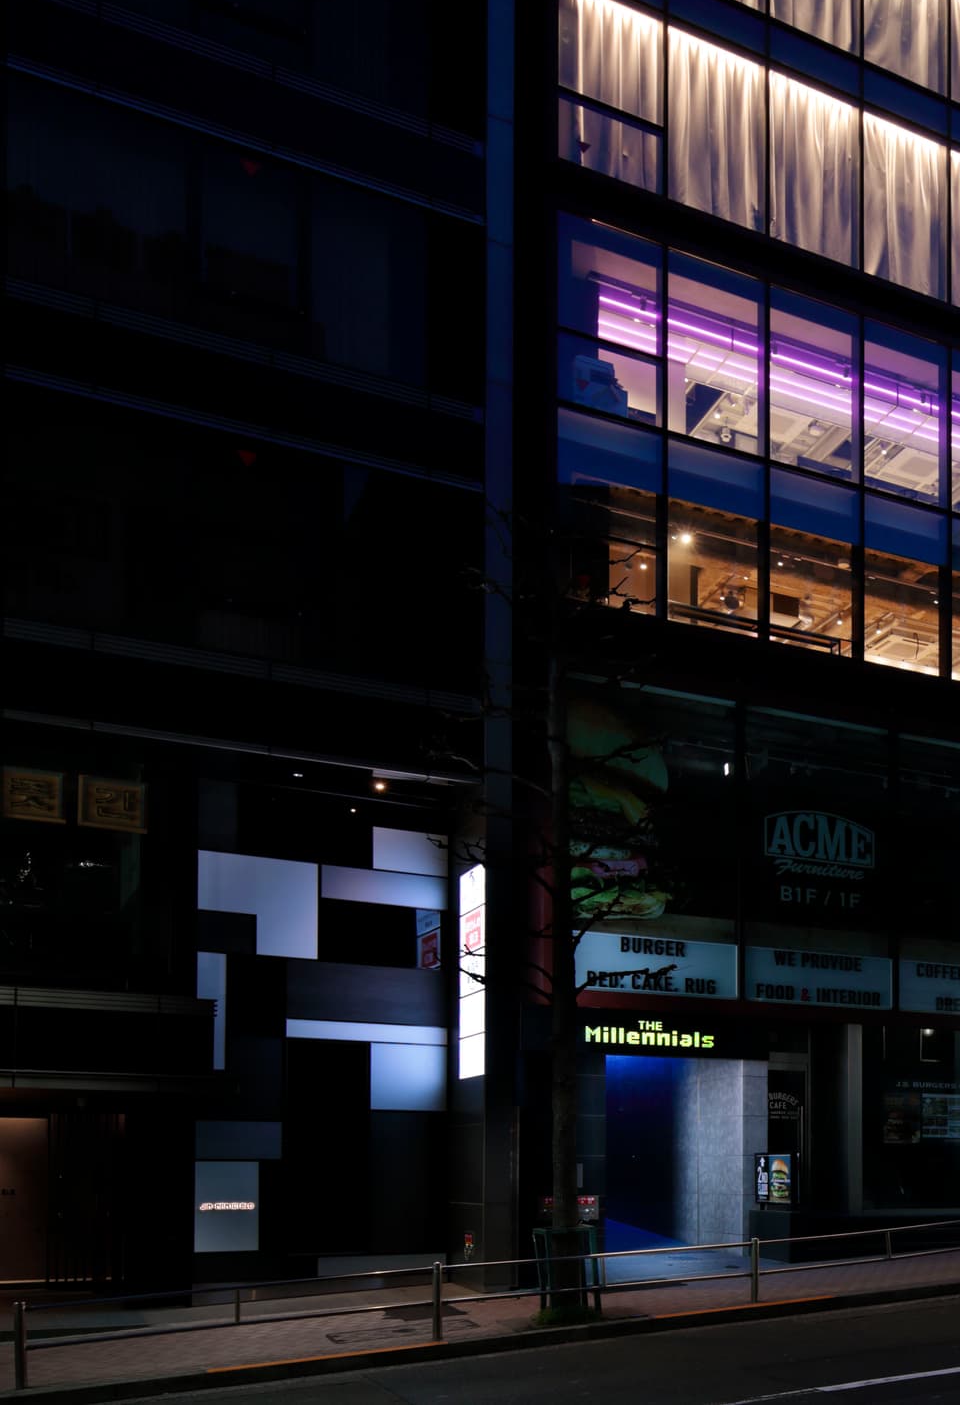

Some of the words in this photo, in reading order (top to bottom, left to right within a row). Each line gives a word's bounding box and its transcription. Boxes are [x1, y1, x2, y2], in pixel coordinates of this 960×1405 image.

[768, 814, 873, 866] ACME
[773, 859, 865, 880] Furniture
[780, 886, 816, 903] B1F
[840, 891, 861, 908] 1F
[620, 936, 686, 958] BURGER
[774, 950, 796, 968] WE
[800, 952, 863, 972] PROVIDE
[685, 977, 717, 995] RUG
[755, 983, 794, 1000] FOOD
[800, 988, 811, 1002] &
[816, 988, 881, 1006] INTERIOR
[637, 1019, 663, 1031] THE
[584, 1025, 716, 1049] Millennials
[769, 1101, 787, 1109] CAFE
